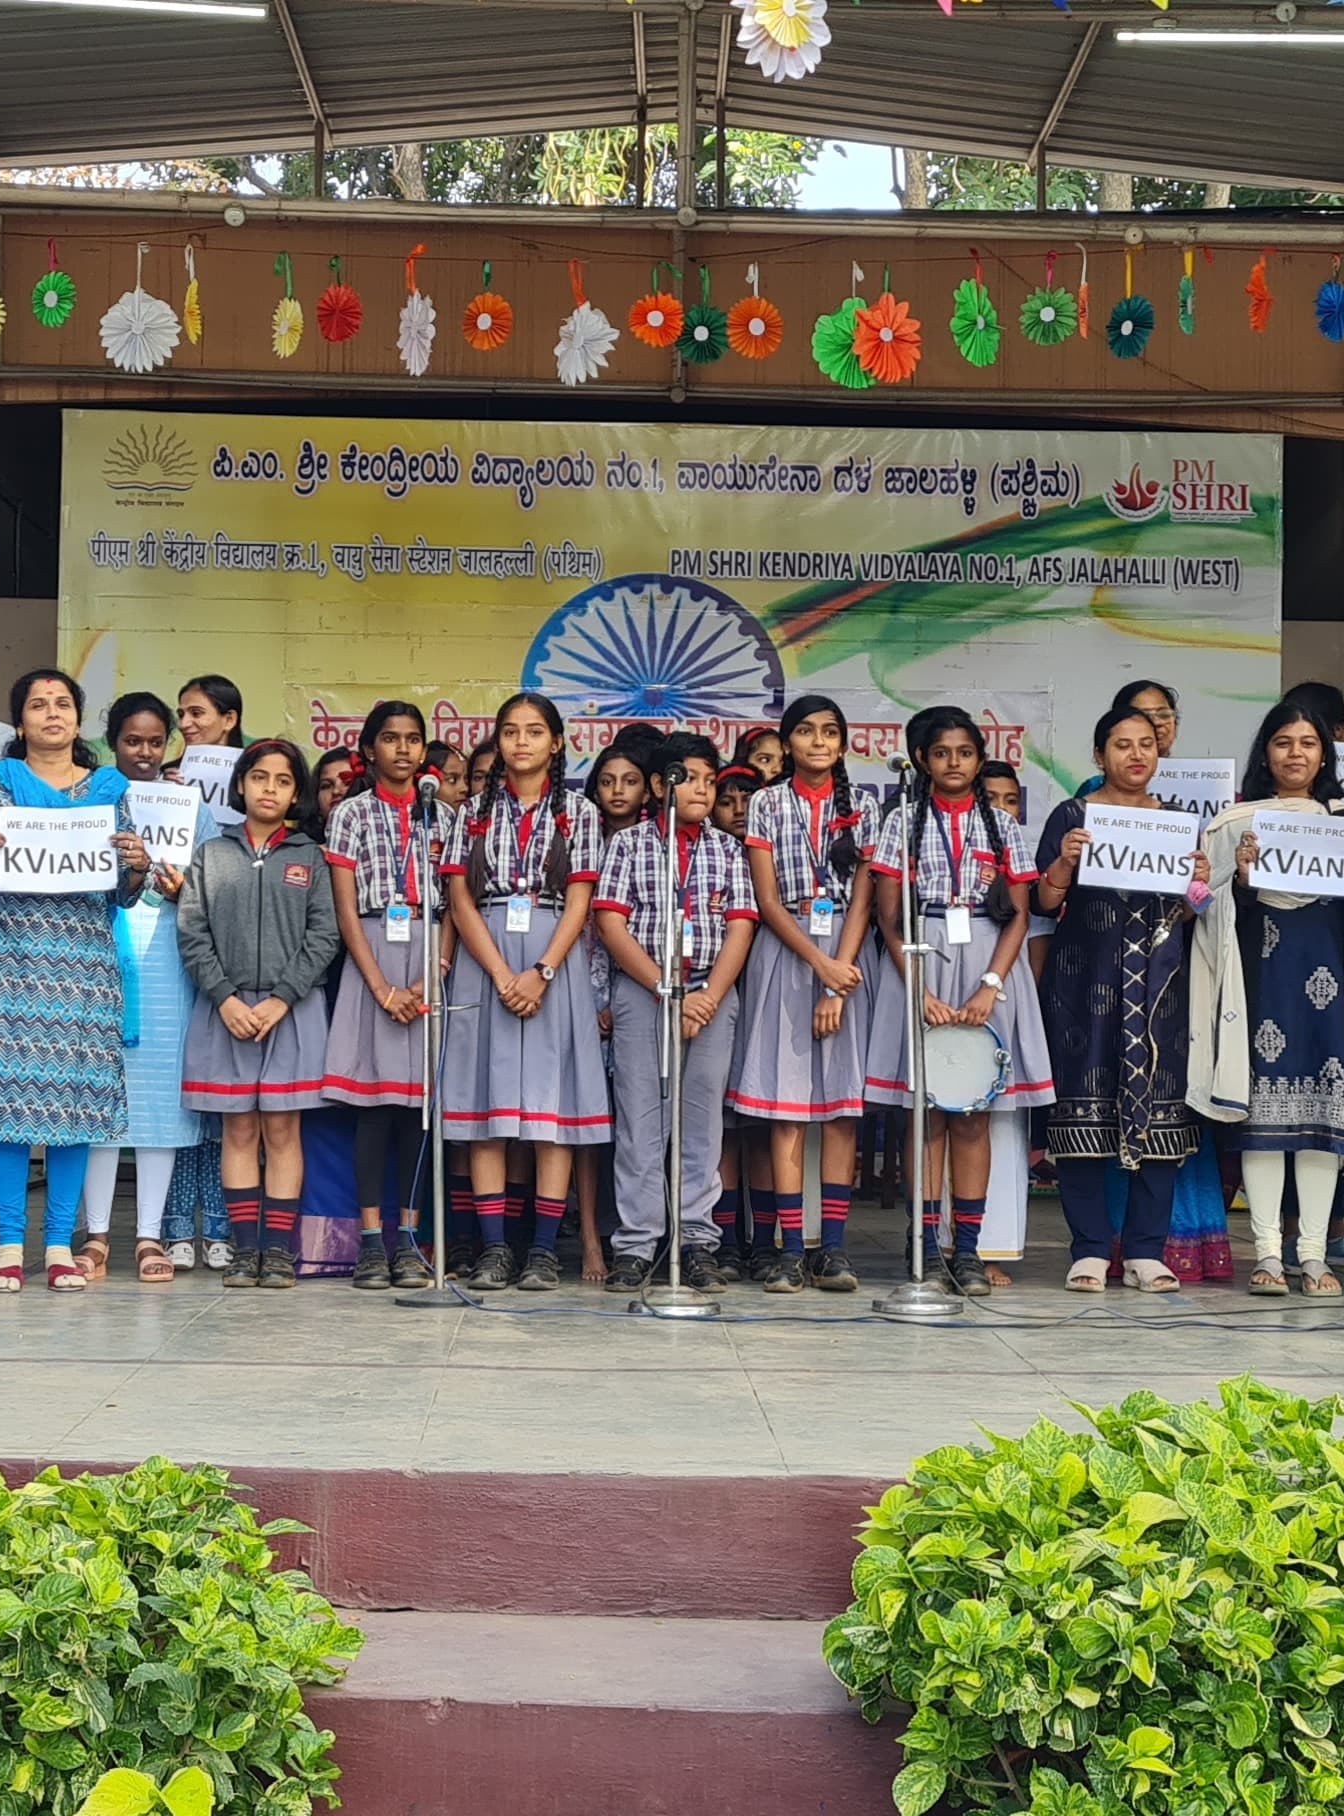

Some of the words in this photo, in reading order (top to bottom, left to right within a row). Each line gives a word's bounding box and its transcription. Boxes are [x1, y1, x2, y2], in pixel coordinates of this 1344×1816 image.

[294, 440, 328, 495] ಶ್ರೀ
[471, 450, 594, 509] ವಿದ್ಯಾಲಯ
[834, 456, 872, 494] ದಳ
[1172, 459, 1216, 482] PM
[1172, 483, 1249, 511] SHRI
[90, 531, 130, 569] पीएम
[137, 532, 156, 566] श्री
[213, 533, 278, 568] विद्यालय
[332, 545, 365, 580] वायु
[369, 535, 402, 572] सेना
[407, 536, 453, 574] स्टेशन
[457, 540, 535, 579] जालहल्ली
[671, 549, 702, 577] PM
[708, 550, 751, 578] SHRI
[759, 552, 854, 579] KENDRIYA
[860, 553, 963, 581] VIDYALAYA
[969, 556, 1021, 587] NO.1,
[1028, 557, 1061, 583] AFS
[1069, 557, 1165, 585] JALAHALLI
[1173, 556, 1240, 591] (WEST)
[202, 756, 221, 766] ARE
[1159, 770, 1178, 778] ARE
[1181, 771, 1198, 779] THE
[136, 794, 155, 804] THE
[157, 796, 191, 807] PROUD
[6, 820, 23, 829] WE
[25, 821, 47, 830] ARE
[49, 822, 68, 831] THE
[71, 819, 108, 829] PROUD
[1093, 816, 1108, 826] WE
[1111, 819, 1131, 829] ARE
[1134, 821, 1153, 831] THE
[1156, 824, 1192, 835] PROUD
[1259, 822, 1275, 831] WE
[1278, 824, 1299, 834] ARE
[1302, 826, 1322, 836] THE
